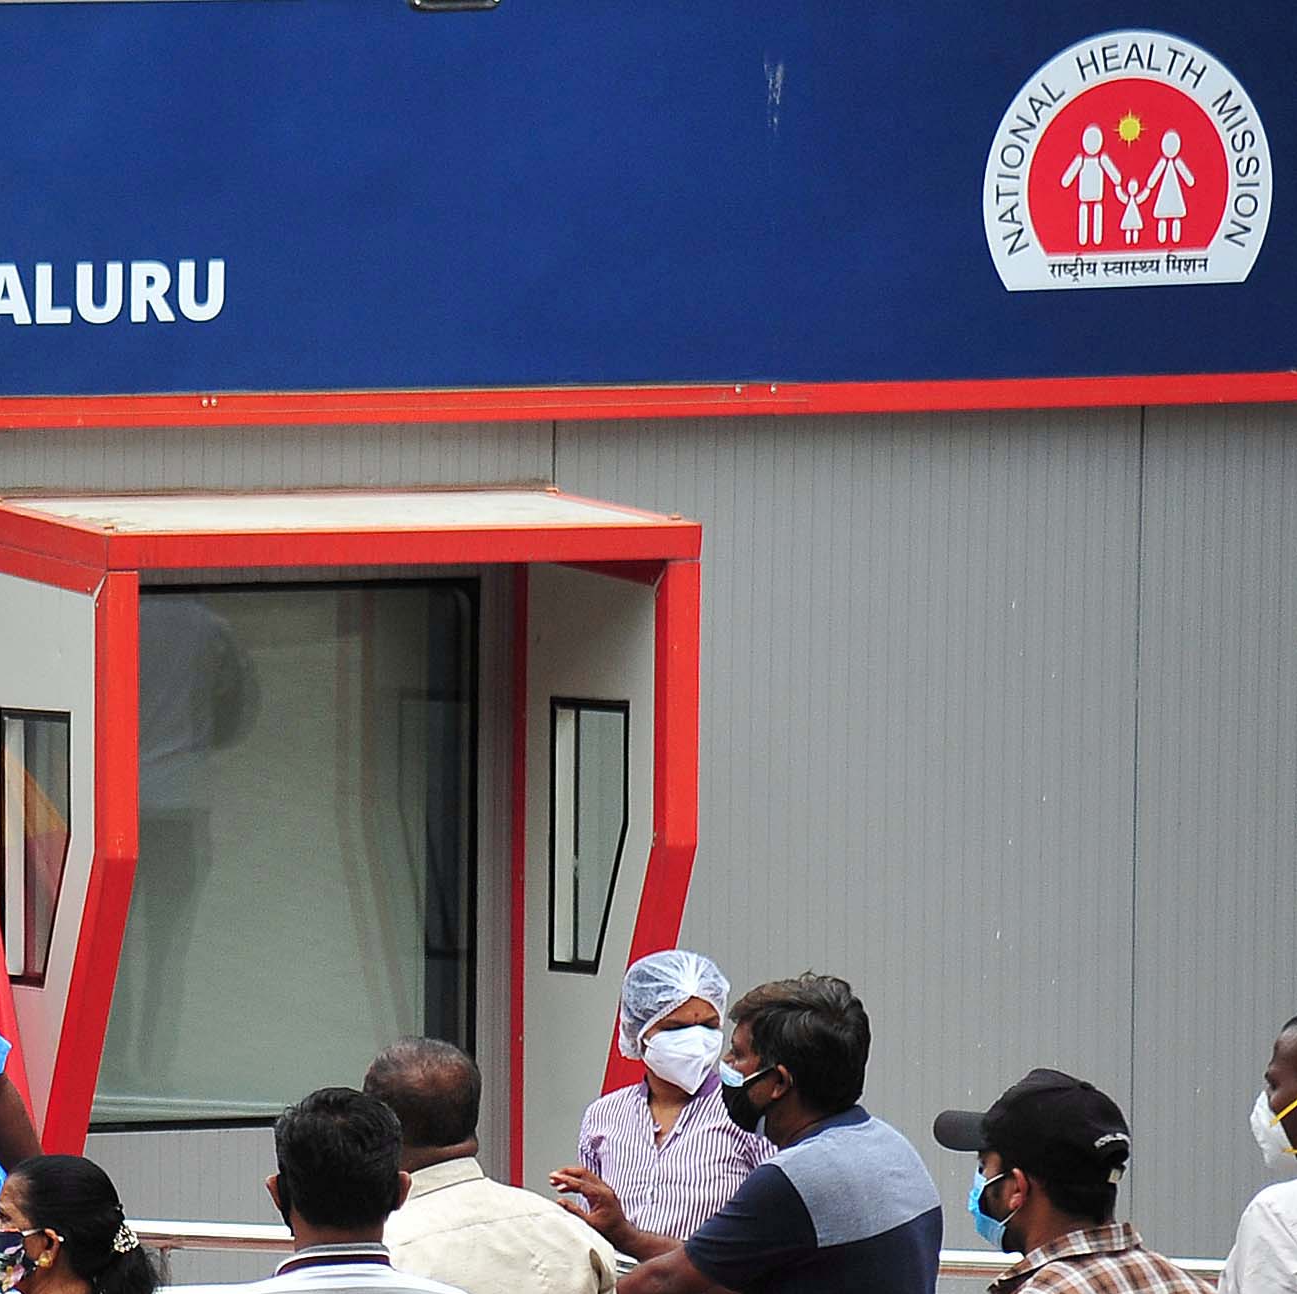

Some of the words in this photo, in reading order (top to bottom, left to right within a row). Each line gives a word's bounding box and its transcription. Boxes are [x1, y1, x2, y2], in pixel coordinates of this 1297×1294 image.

[995, 80, 1066, 257] NATIONAL
[1075, 42, 1206, 90] HEALTH
[1211, 88, 1261, 248] MISSION
[1048, 256, 1098, 282] राष्ट्रीय
[1102, 258, 1161, 277] स्वास्थ्य
[1165, 252, 1209, 274] मिशन
